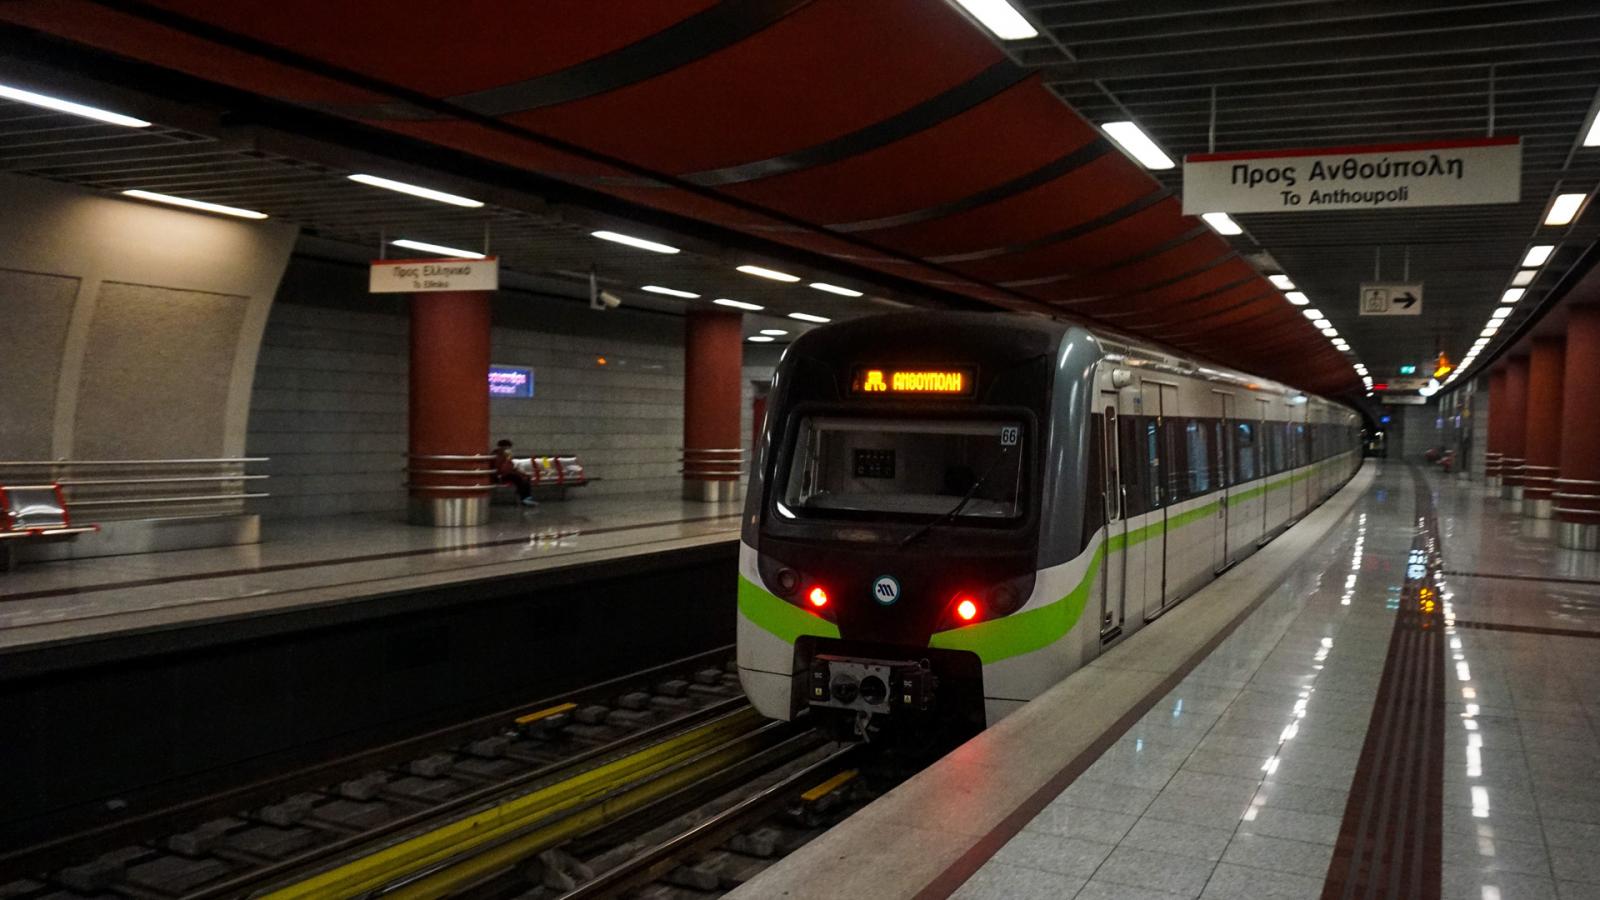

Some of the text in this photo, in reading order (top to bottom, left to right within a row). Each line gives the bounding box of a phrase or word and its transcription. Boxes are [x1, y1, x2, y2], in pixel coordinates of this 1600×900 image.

[1231, 154, 1465, 188] Προς Ανθούπολη
[1281, 186, 1409, 206] To Anthoupoli
[1002, 428, 1017, 444] 66
